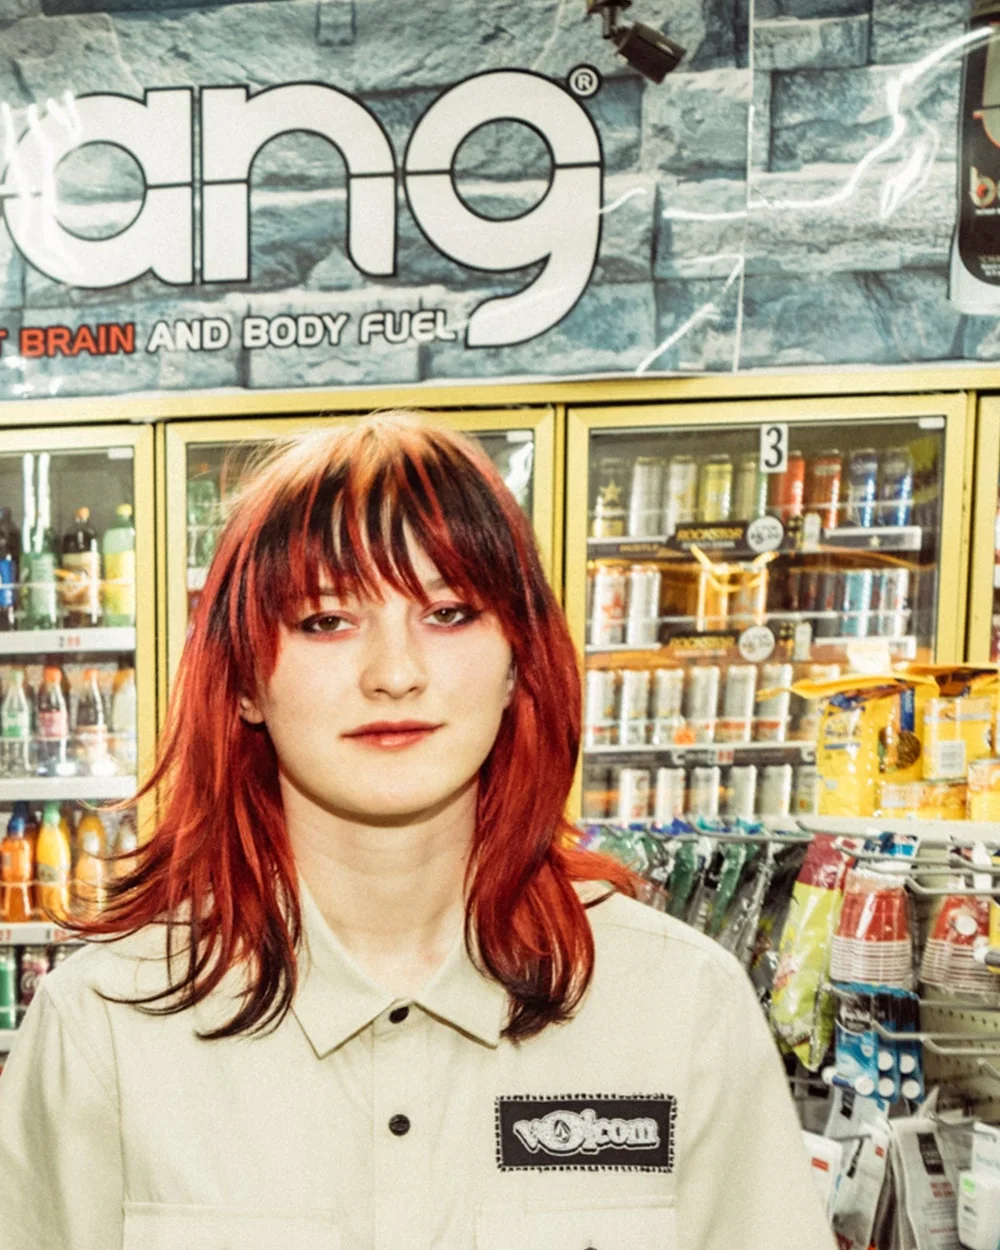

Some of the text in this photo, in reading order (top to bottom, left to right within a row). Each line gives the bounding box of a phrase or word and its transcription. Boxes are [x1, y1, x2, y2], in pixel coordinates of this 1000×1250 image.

[20, 323, 136, 357] BRAIN
[146, 315, 230, 352] AND
[242, 314, 348, 349] BODY
[358, 309, 456, 343] FUEL
[764, 426, 784, 470] 3
